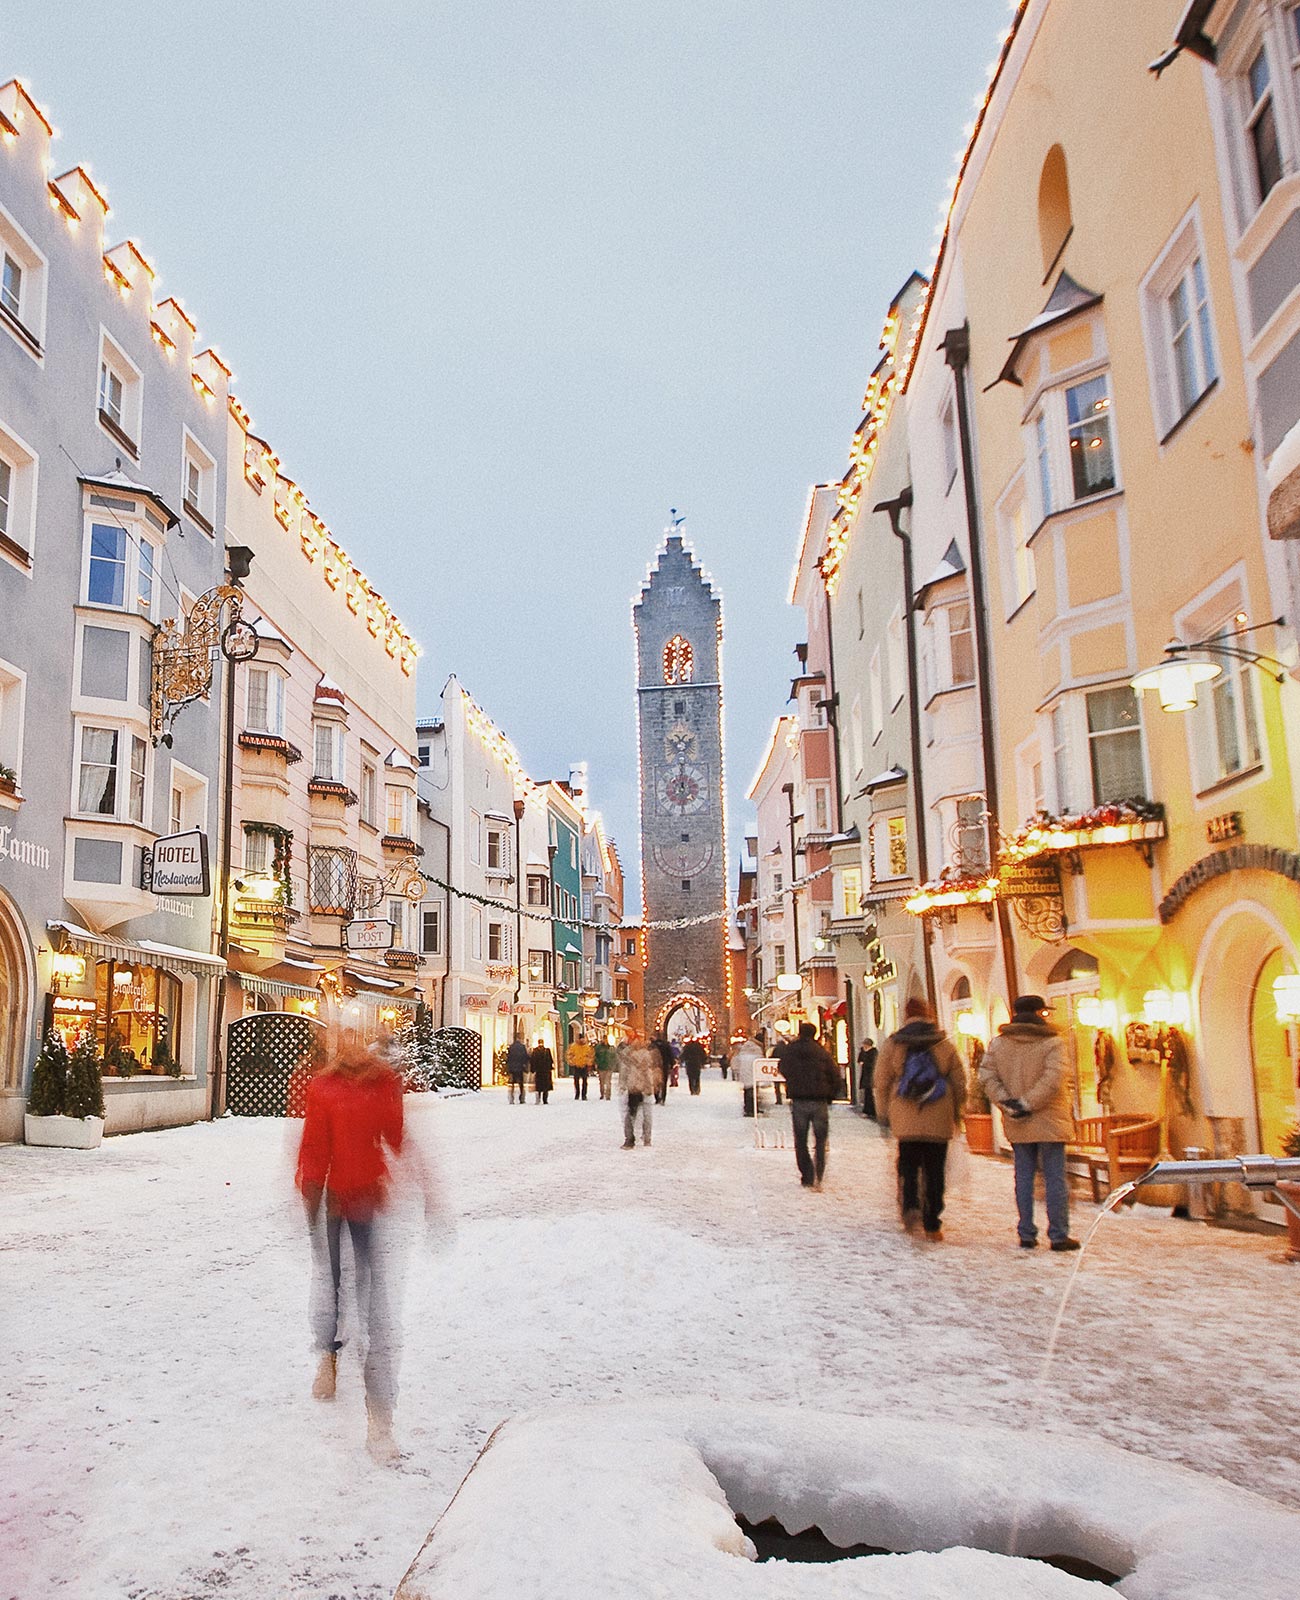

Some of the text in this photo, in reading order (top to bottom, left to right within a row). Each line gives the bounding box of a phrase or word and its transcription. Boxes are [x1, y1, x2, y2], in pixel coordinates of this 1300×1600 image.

[158, 846, 200, 863] HOTEL
[154, 869, 203, 887] Restaurant
[156, 895, 194, 919] estaurant
[357, 932, 384, 942] POST
